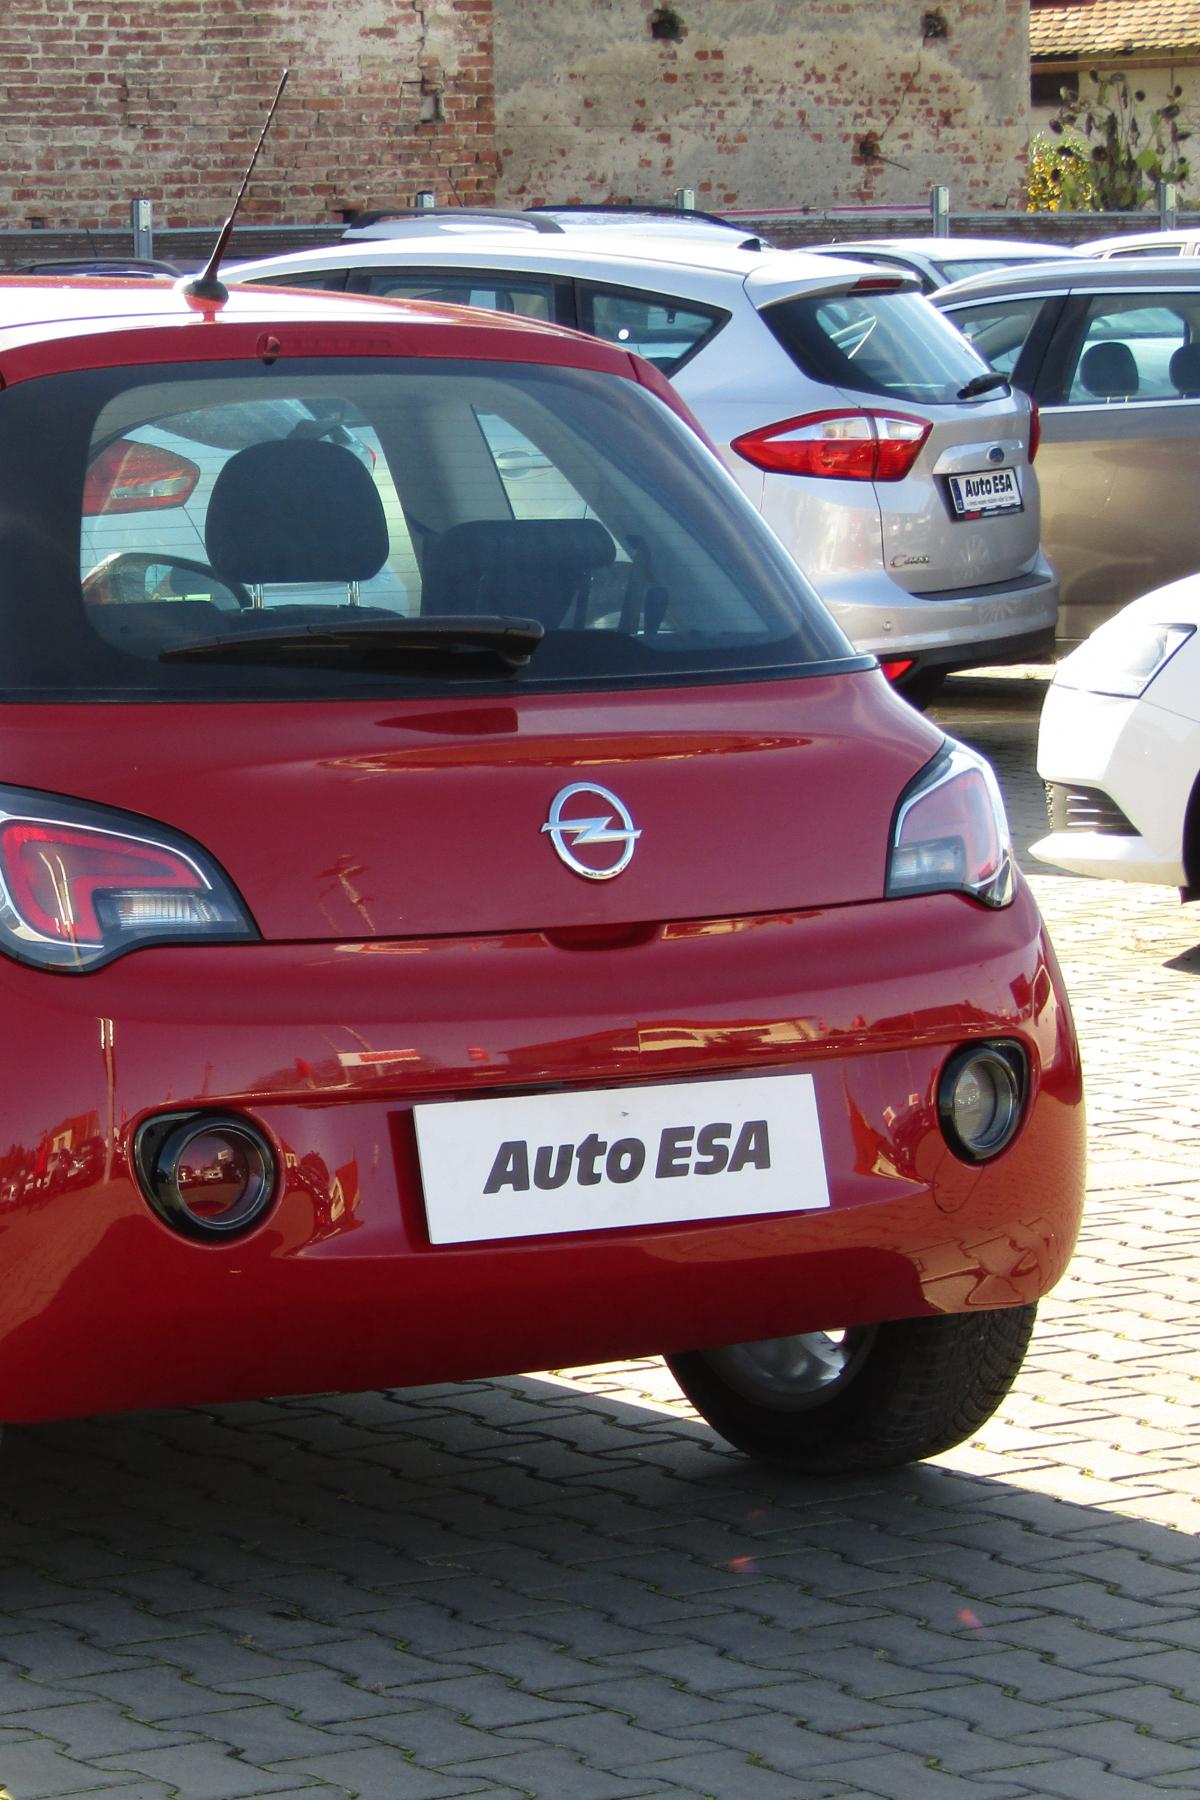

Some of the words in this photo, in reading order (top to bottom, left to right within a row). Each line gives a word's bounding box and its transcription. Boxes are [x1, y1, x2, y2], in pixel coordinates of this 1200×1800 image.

[965, 477, 992, 497] Auto
[992, 474, 1013, 493] ESA
[482, 1133, 646, 1194] Auto
[655, 1120, 771, 1179] ESA
